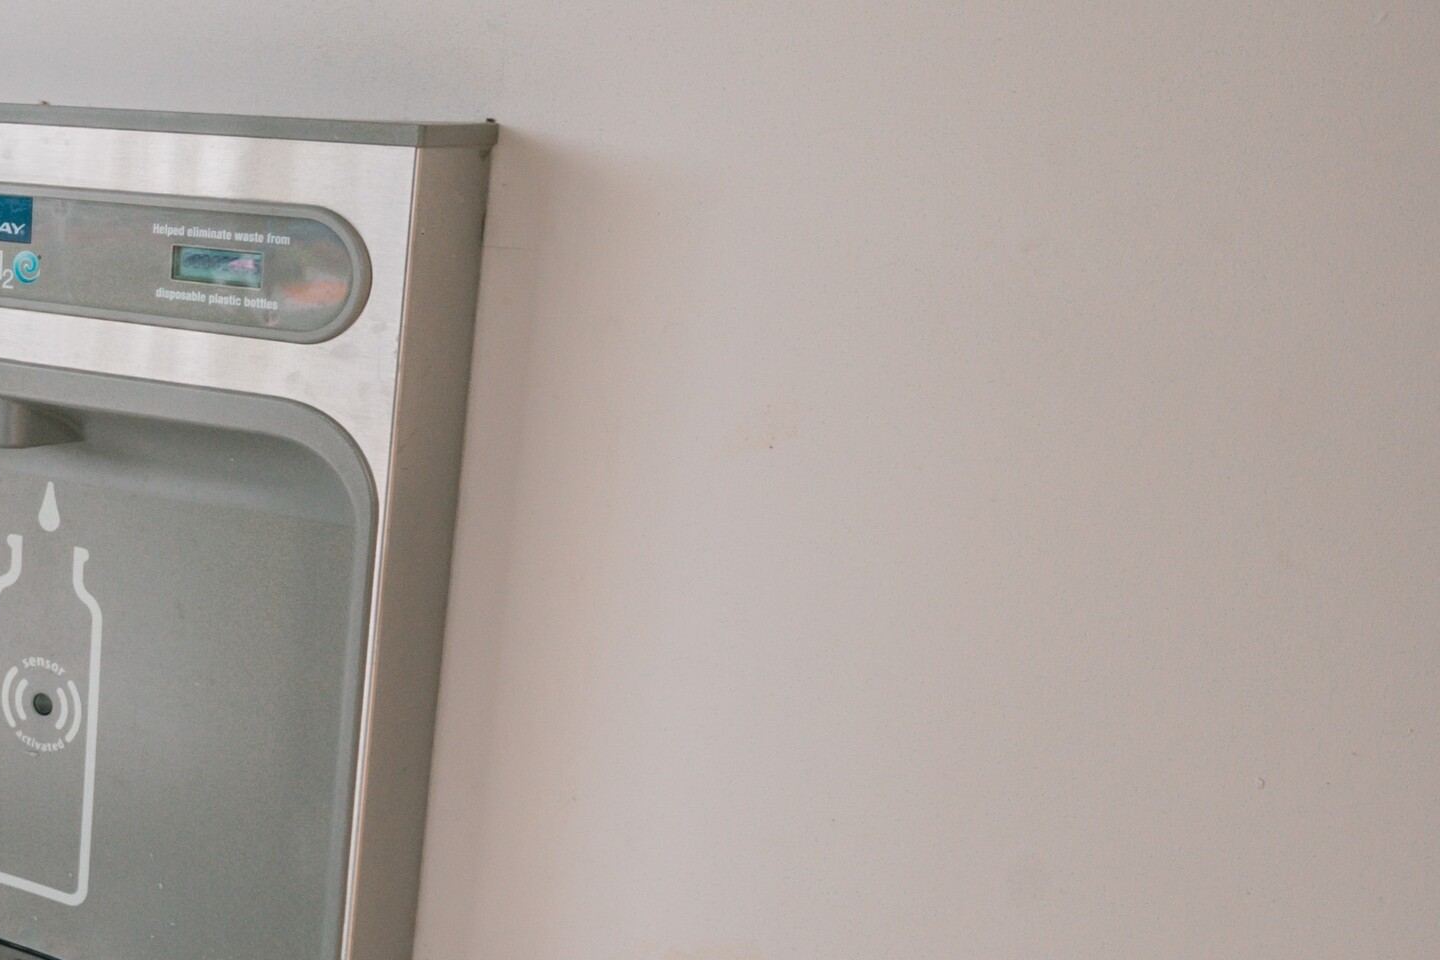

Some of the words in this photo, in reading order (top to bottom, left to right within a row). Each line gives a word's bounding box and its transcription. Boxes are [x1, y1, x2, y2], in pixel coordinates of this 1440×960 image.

[153, 224, 185, 237] Helped
[187, 227, 232, 240] eliminate
[234, 232, 264, 243] waste
[267, 233, 290, 245] from
[156, 288, 206, 302] disposable
[208, 293, 242, 306] plastic
[243, 296, 279, 310] bottles
[22, 656, 66, 675] sensor
[16, 729, 65, 752] activated
